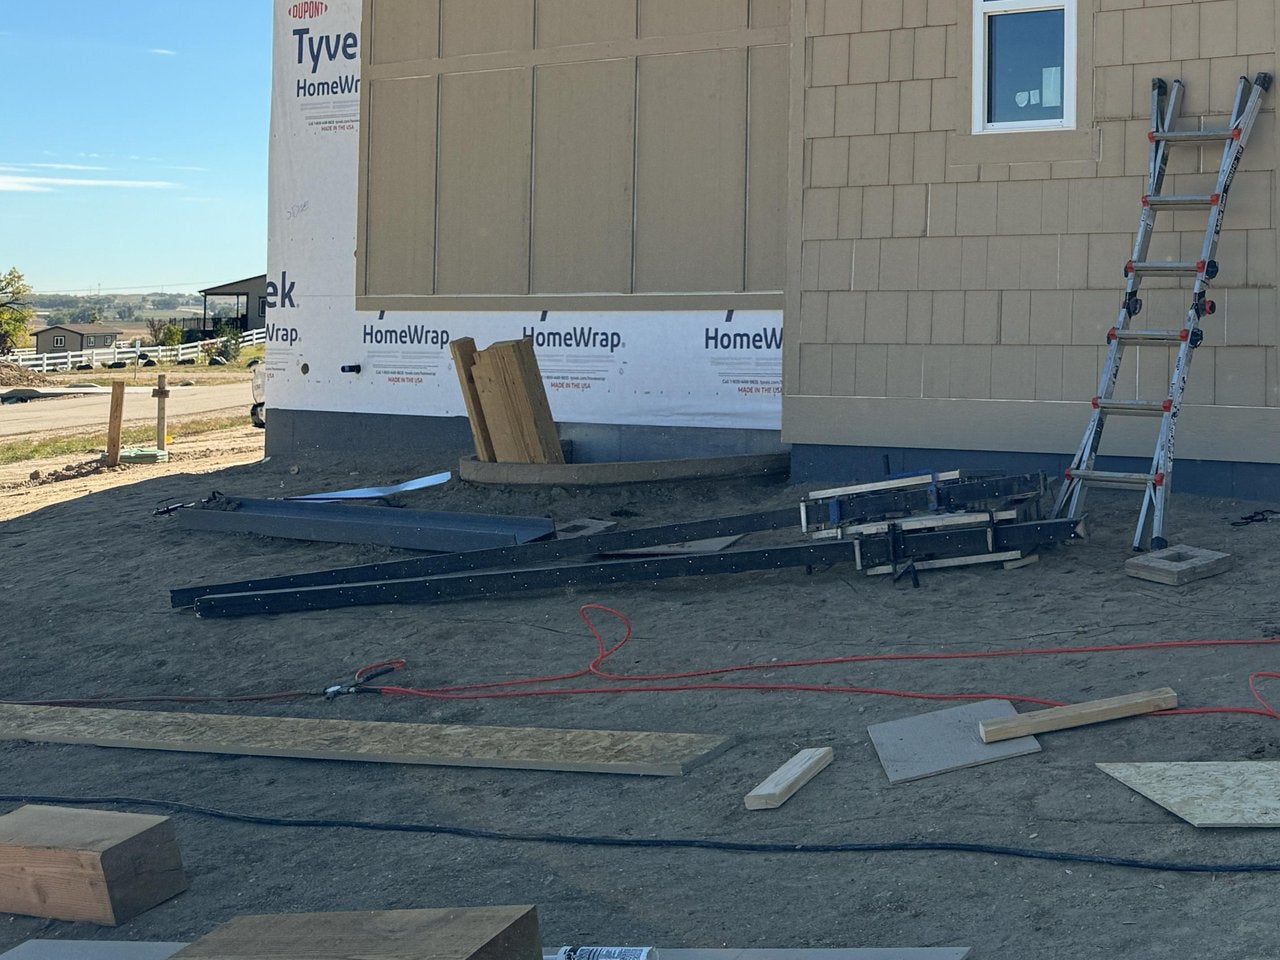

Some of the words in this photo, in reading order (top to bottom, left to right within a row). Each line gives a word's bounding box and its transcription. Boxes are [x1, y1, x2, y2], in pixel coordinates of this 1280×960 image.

[292, 0, 324, 19] DUPONT
[292, 27, 358, 74] Tyve
[296, 74, 360, 97] HomeWr
[363, 324, 450, 349] HomeWrap
[523, 326, 621, 353] HomeWrap
[705, 327, 783, 349] HomeW
